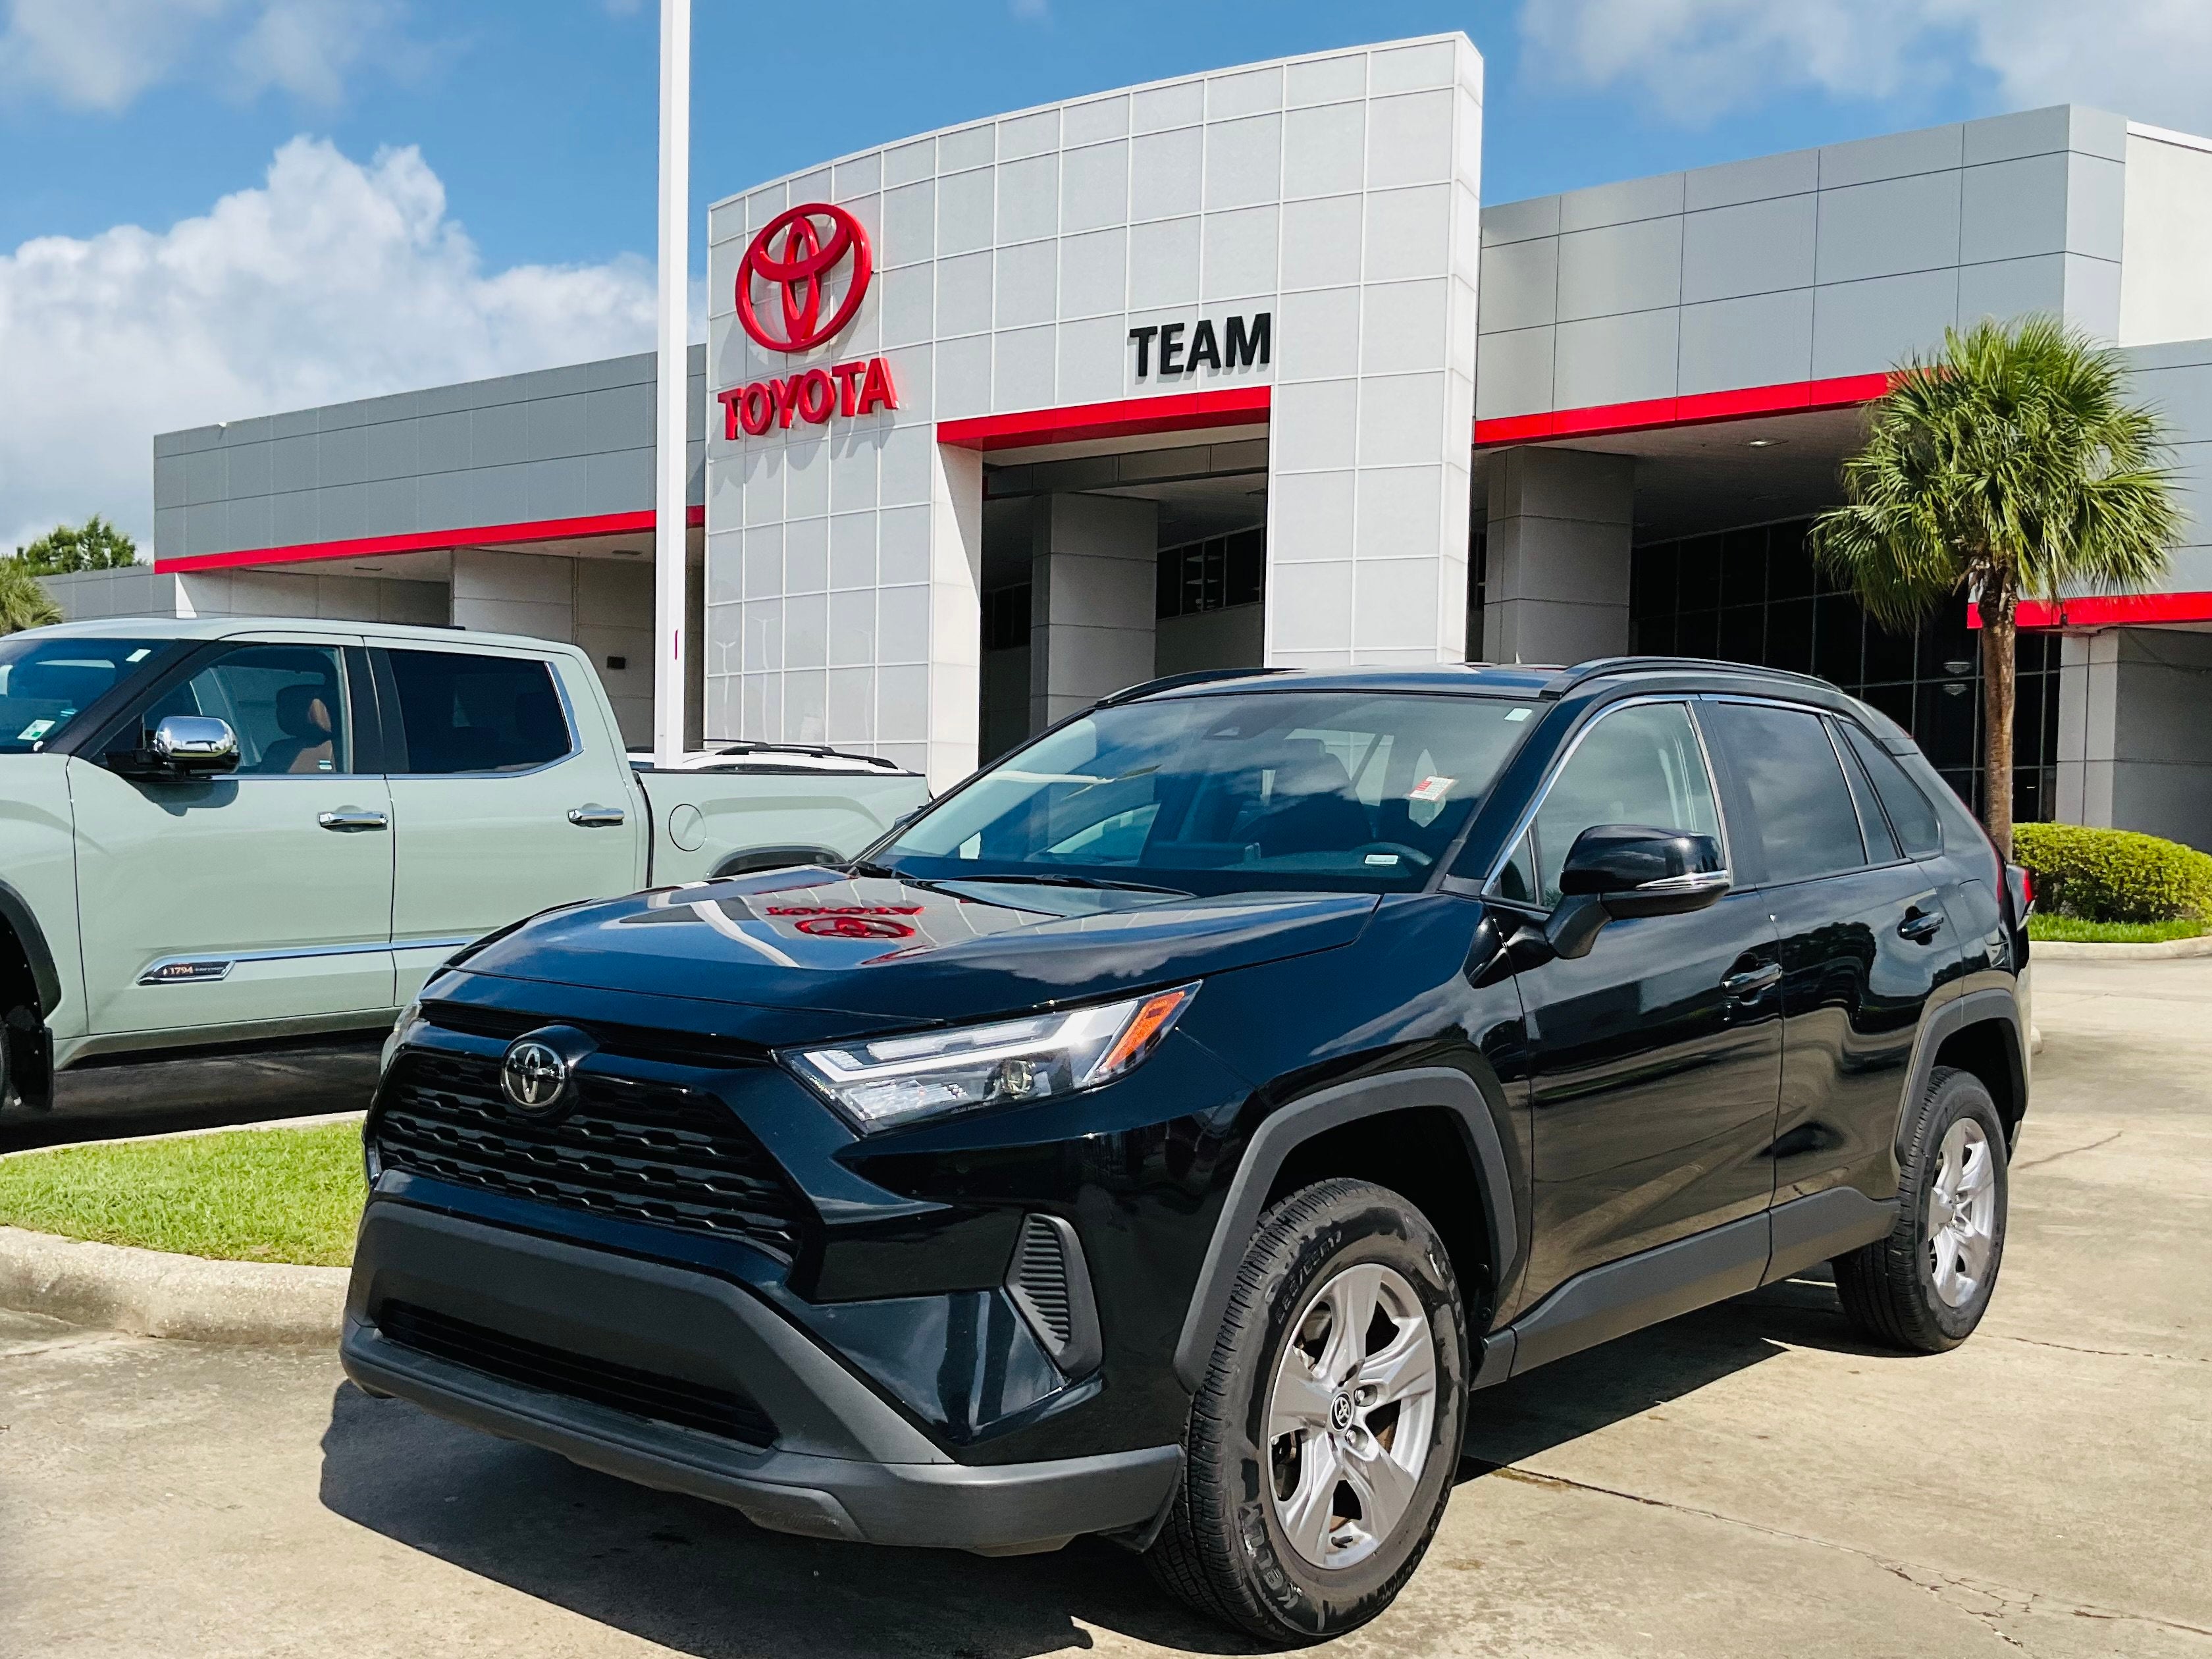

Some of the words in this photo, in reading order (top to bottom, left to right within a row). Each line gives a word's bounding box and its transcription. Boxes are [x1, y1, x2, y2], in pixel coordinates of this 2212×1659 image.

[1130, 313, 1271, 377] TEAM
[718, 357, 900, 440] TOYOTA
[169, 966, 194, 975] 1794
